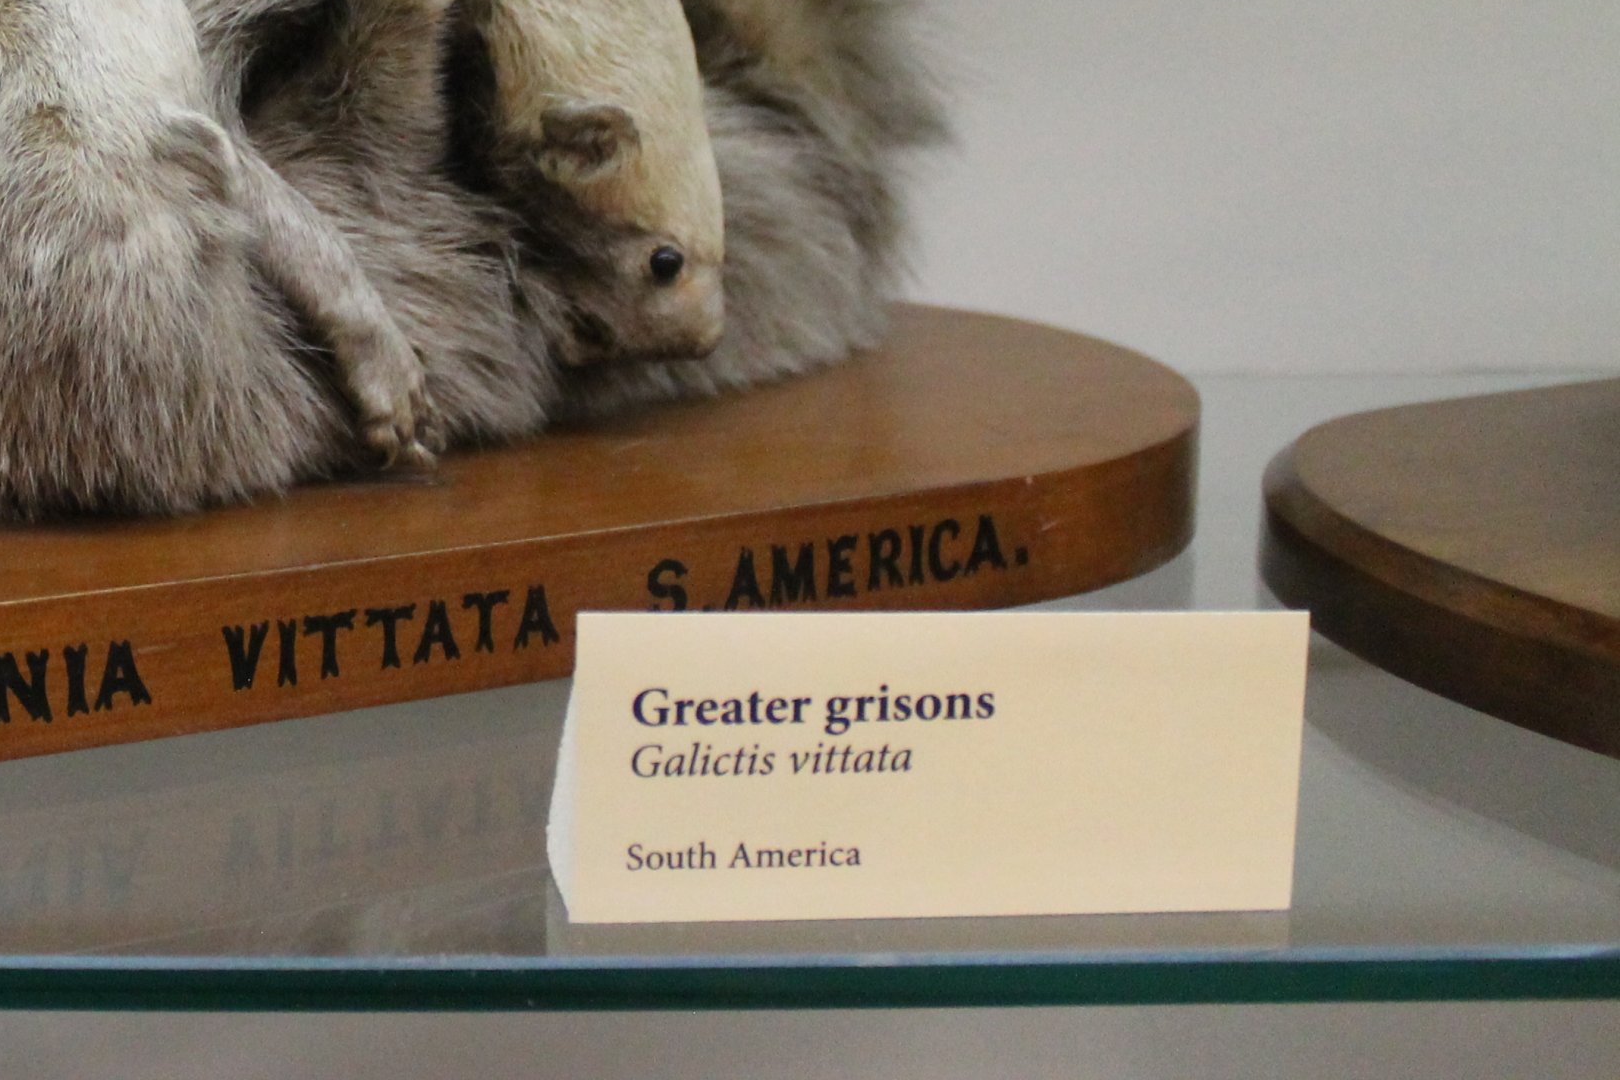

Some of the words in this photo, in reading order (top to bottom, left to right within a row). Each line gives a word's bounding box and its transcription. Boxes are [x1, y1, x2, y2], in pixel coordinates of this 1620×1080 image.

[222, 584, 560, 691] VITTATA
[632, 688, 812, 727] Greater
[824, 684, 996, 735] grisons
[630, 742, 777, 778] Galictis
[790, 742, 913, 776] vittata
[626, 841, 717, 871] South
[728, 841, 862, 870] America
